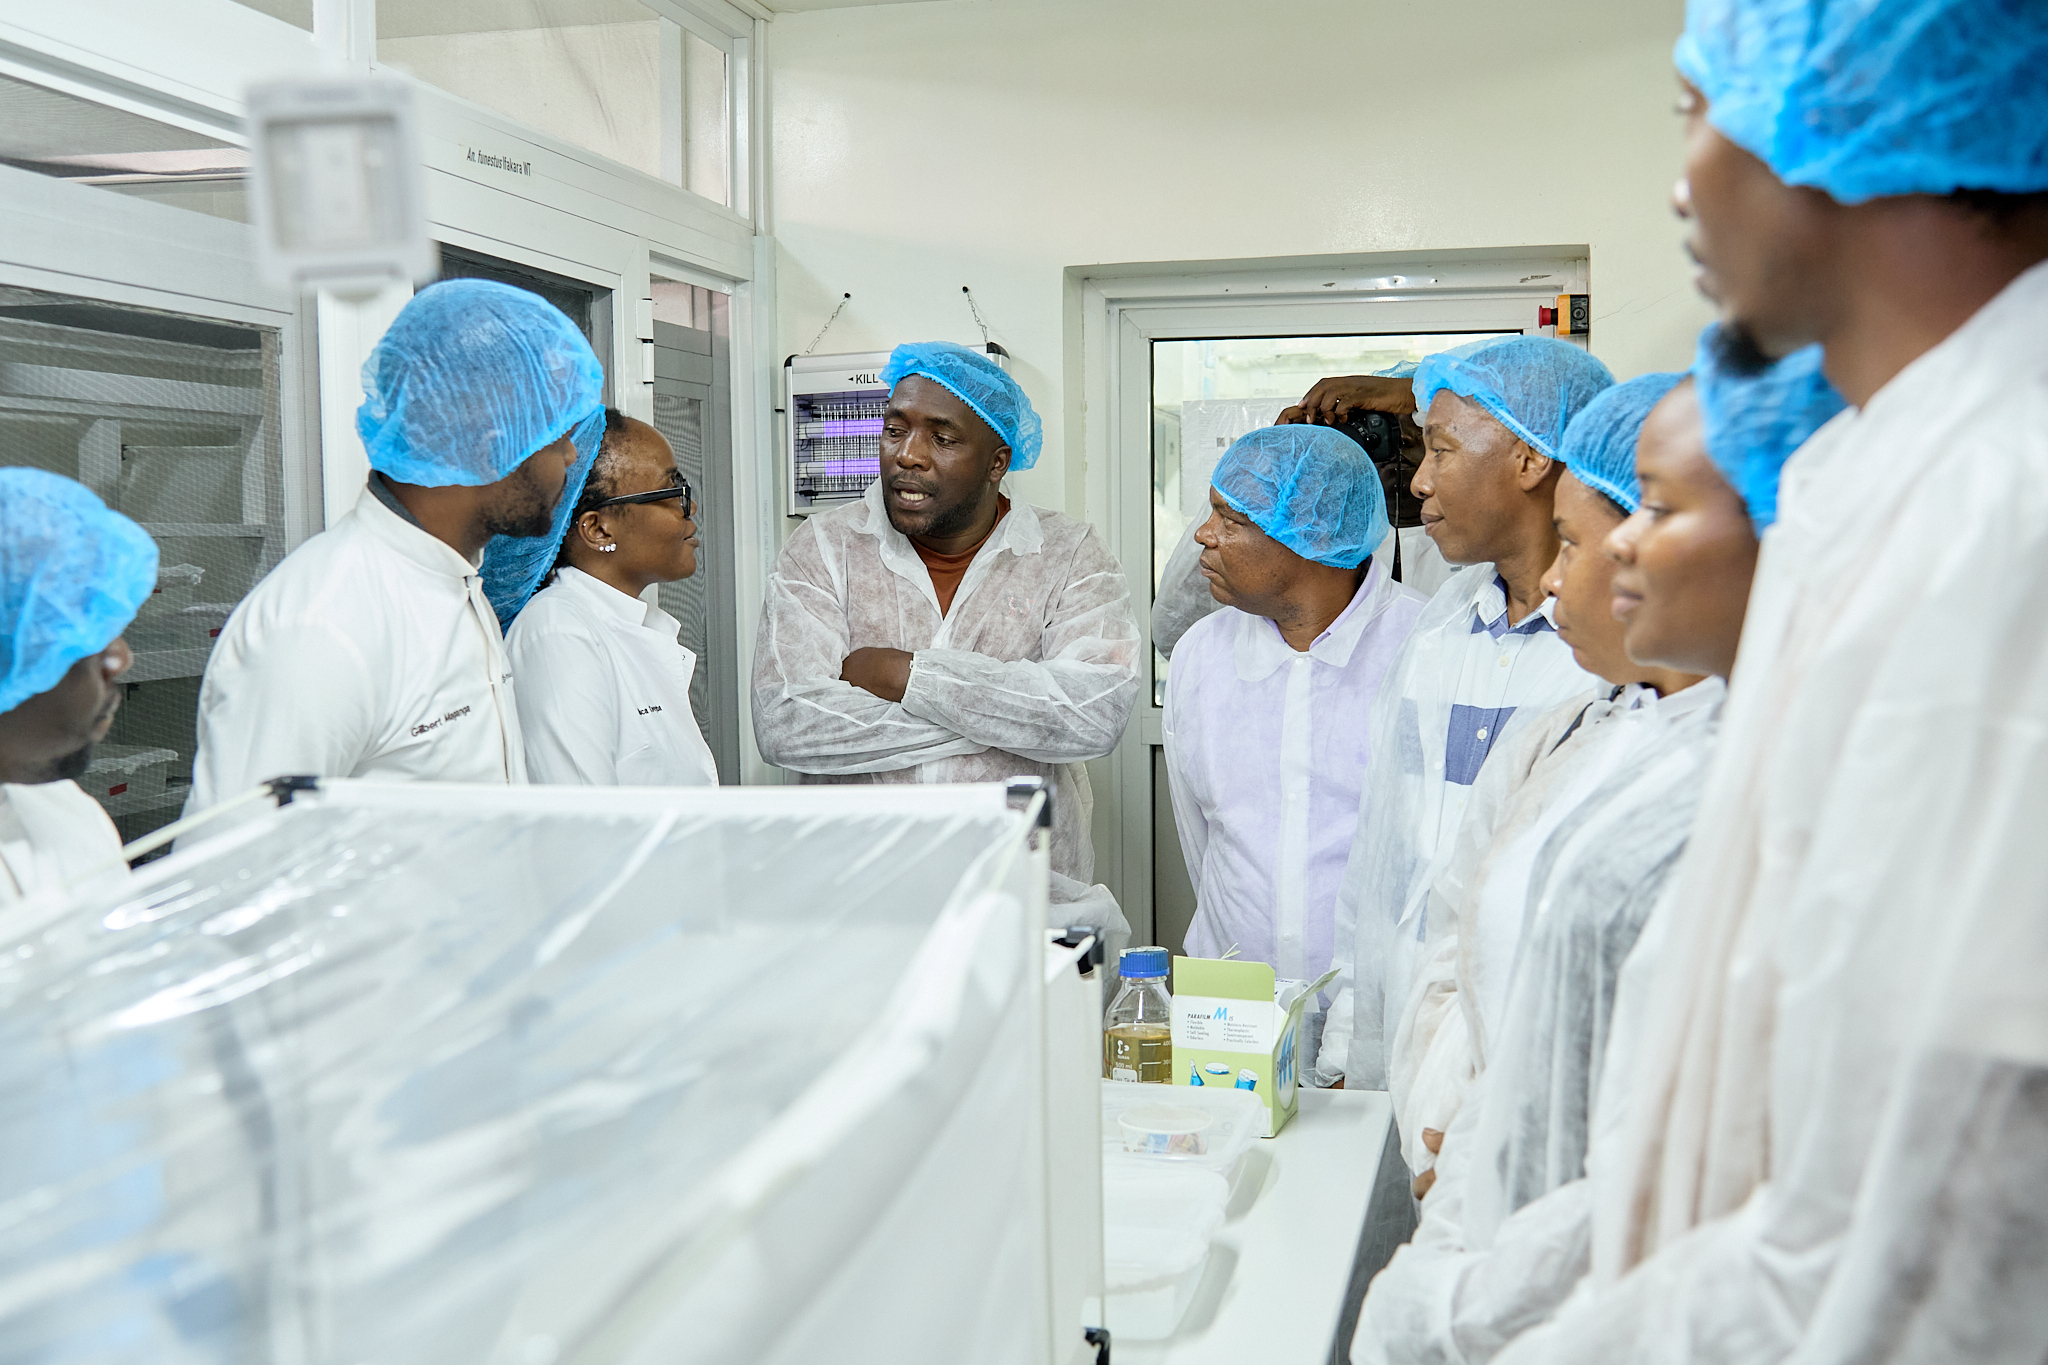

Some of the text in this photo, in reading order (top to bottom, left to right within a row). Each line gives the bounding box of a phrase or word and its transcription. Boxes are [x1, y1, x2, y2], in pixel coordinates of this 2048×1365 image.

[467, 147, 531, 177] An. funestus Ifakara WT
[1213, 1007, 1227, 1020] M
